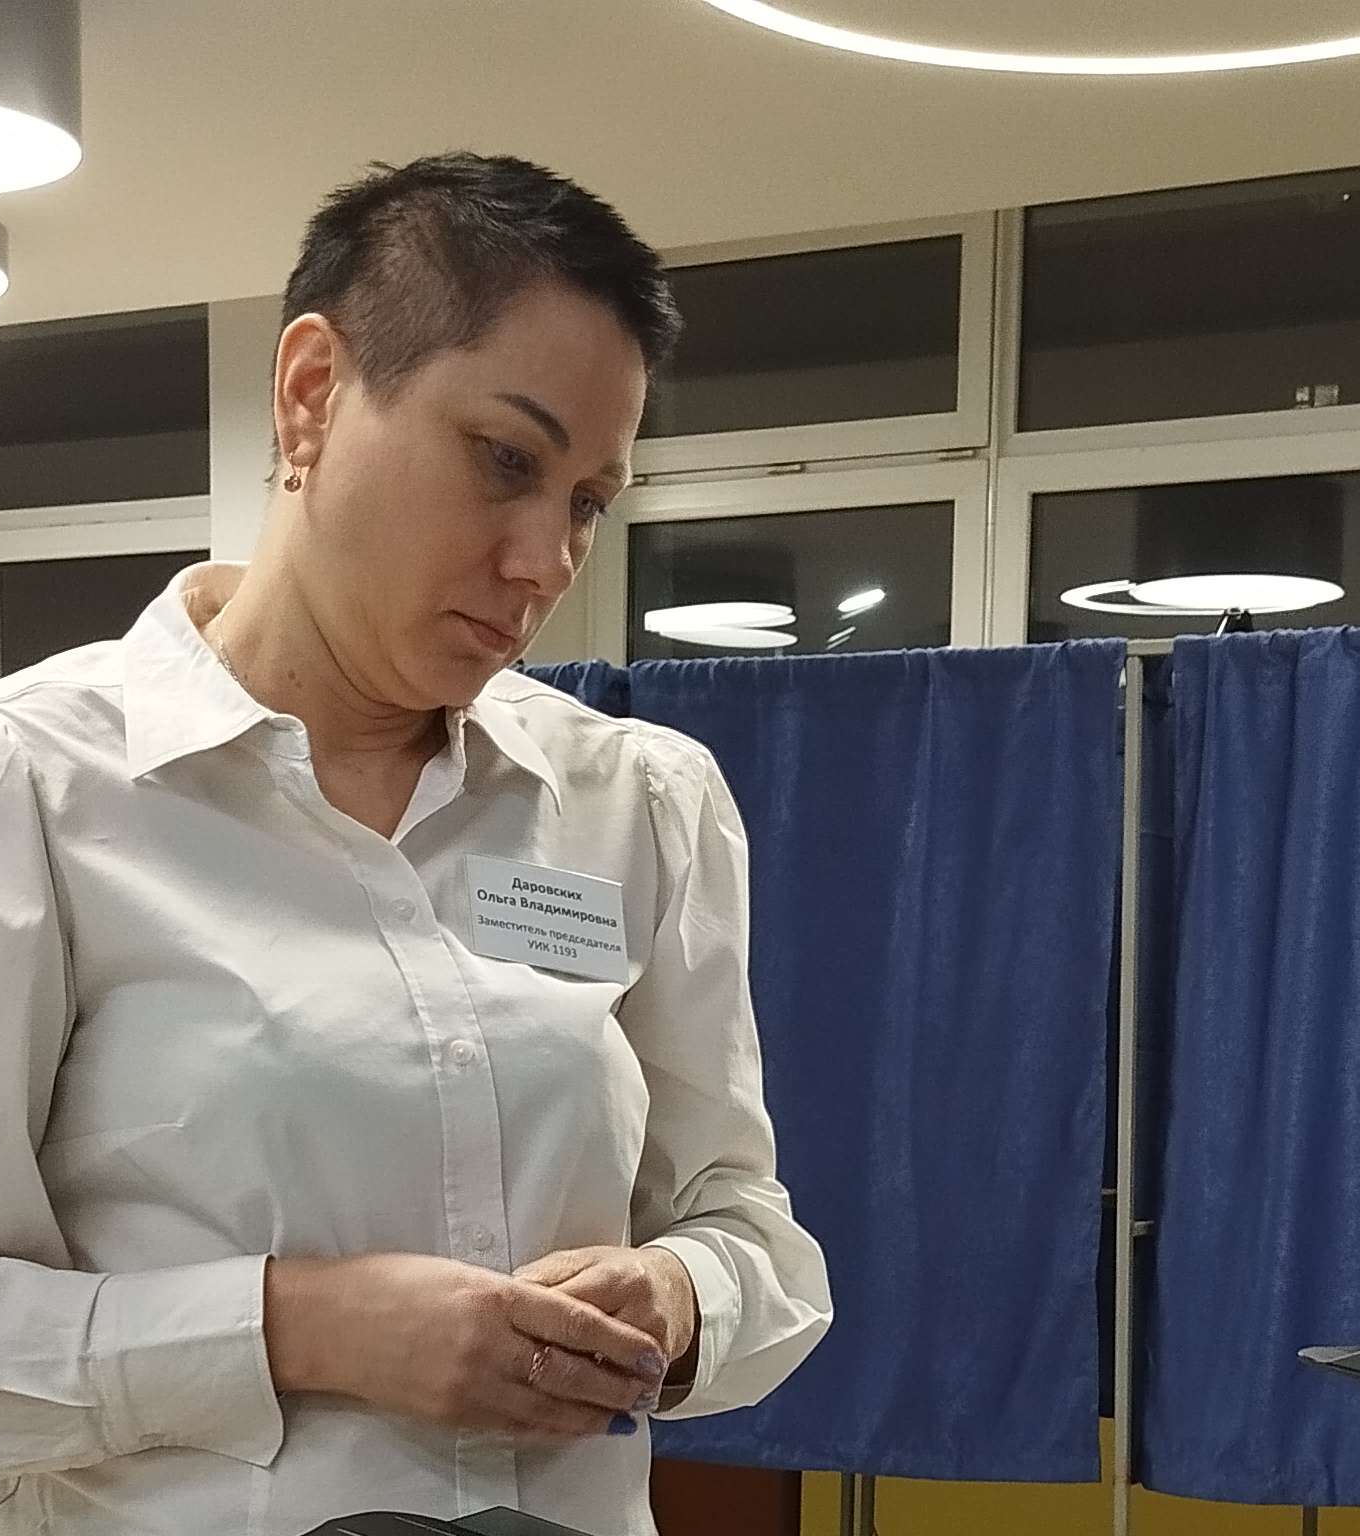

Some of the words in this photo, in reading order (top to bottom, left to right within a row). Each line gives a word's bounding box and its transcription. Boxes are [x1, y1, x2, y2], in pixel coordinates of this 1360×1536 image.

[511, 877, 583, 901] Даровских
[477, 888, 517, 906] Ольга
[520, 896, 618, 928] Владимировна
[477, 914, 547, 936] Заместитель
[549, 929, 621, 952] председателя
[526, 939, 550, 953] УИК
[552, 944, 578, 959] 1193
